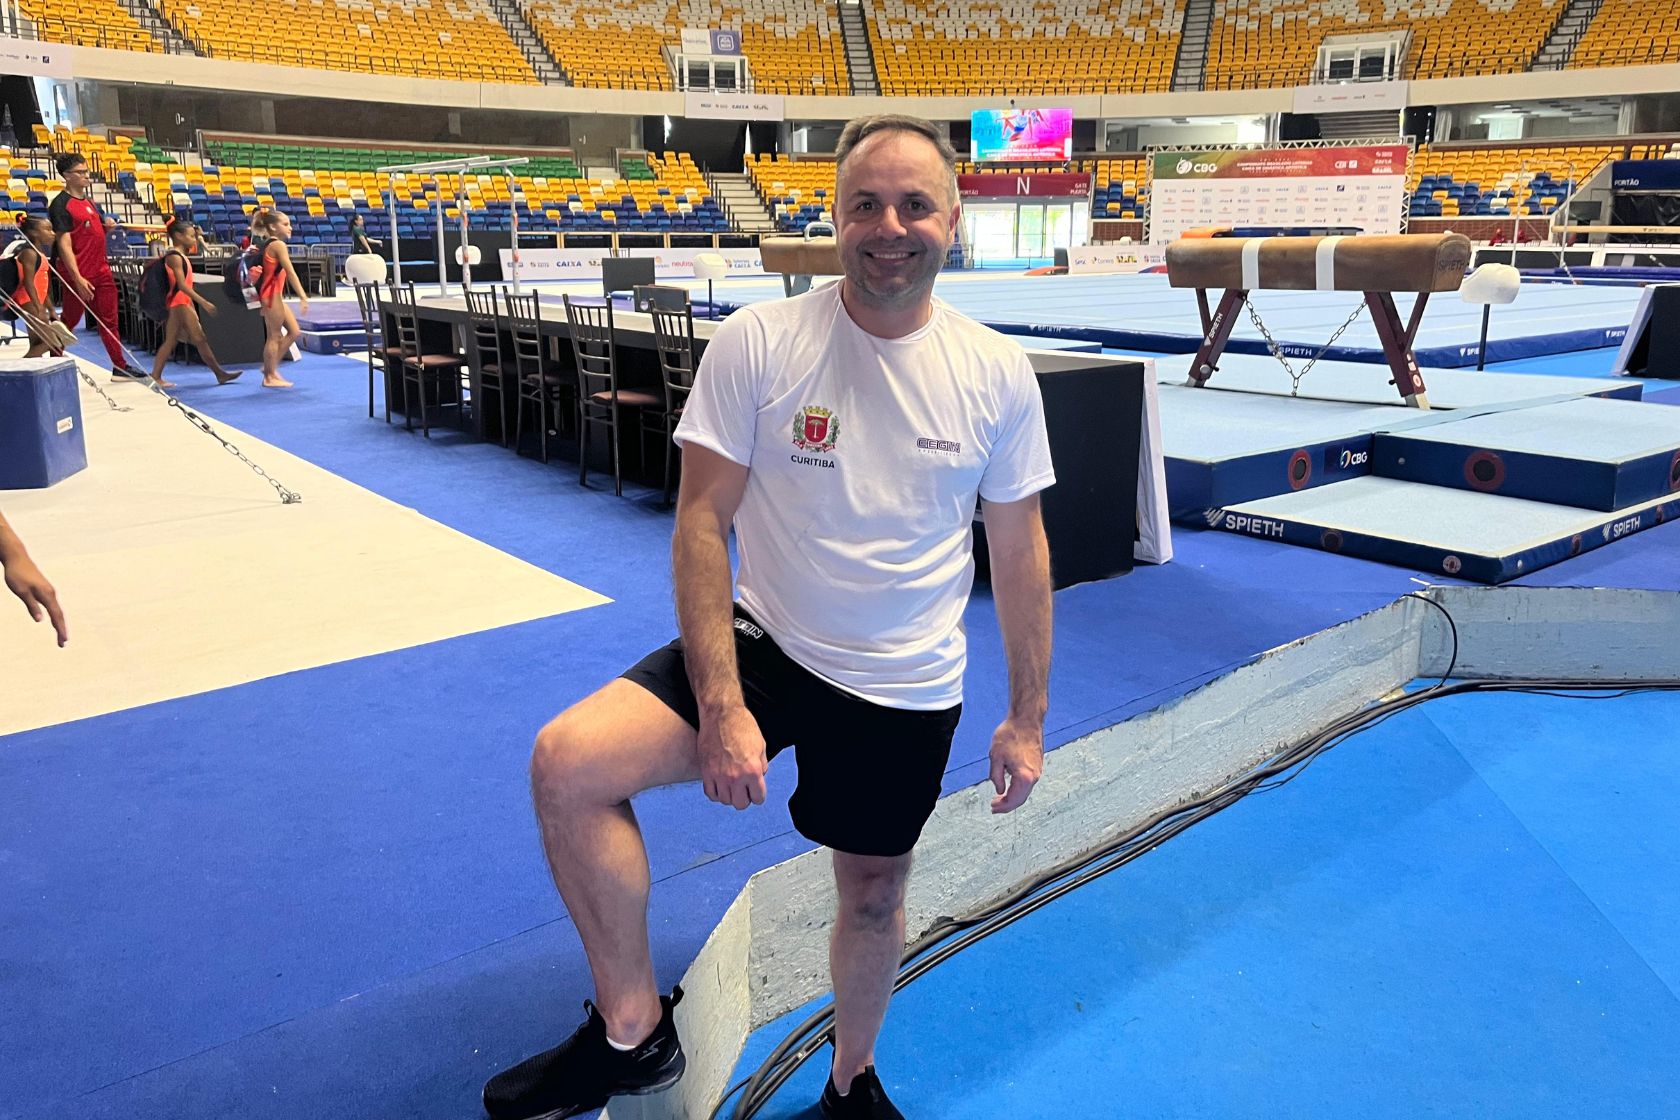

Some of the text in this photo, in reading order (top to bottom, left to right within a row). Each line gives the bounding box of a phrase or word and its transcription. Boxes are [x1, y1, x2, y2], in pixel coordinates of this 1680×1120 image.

[1193, 163, 1218, 173] CBG
[1016, 176, 1031, 195] N
[1208, 312, 1224, 339] SPIETH
[1280, 346, 1312, 356] SPIETH
[790, 454, 835, 468] CURITIBA
[1351, 451, 1368, 465] CBG
[1225, 513, 1285, 538] SPIETH
[1613, 515, 1641, 537] SPIETH
